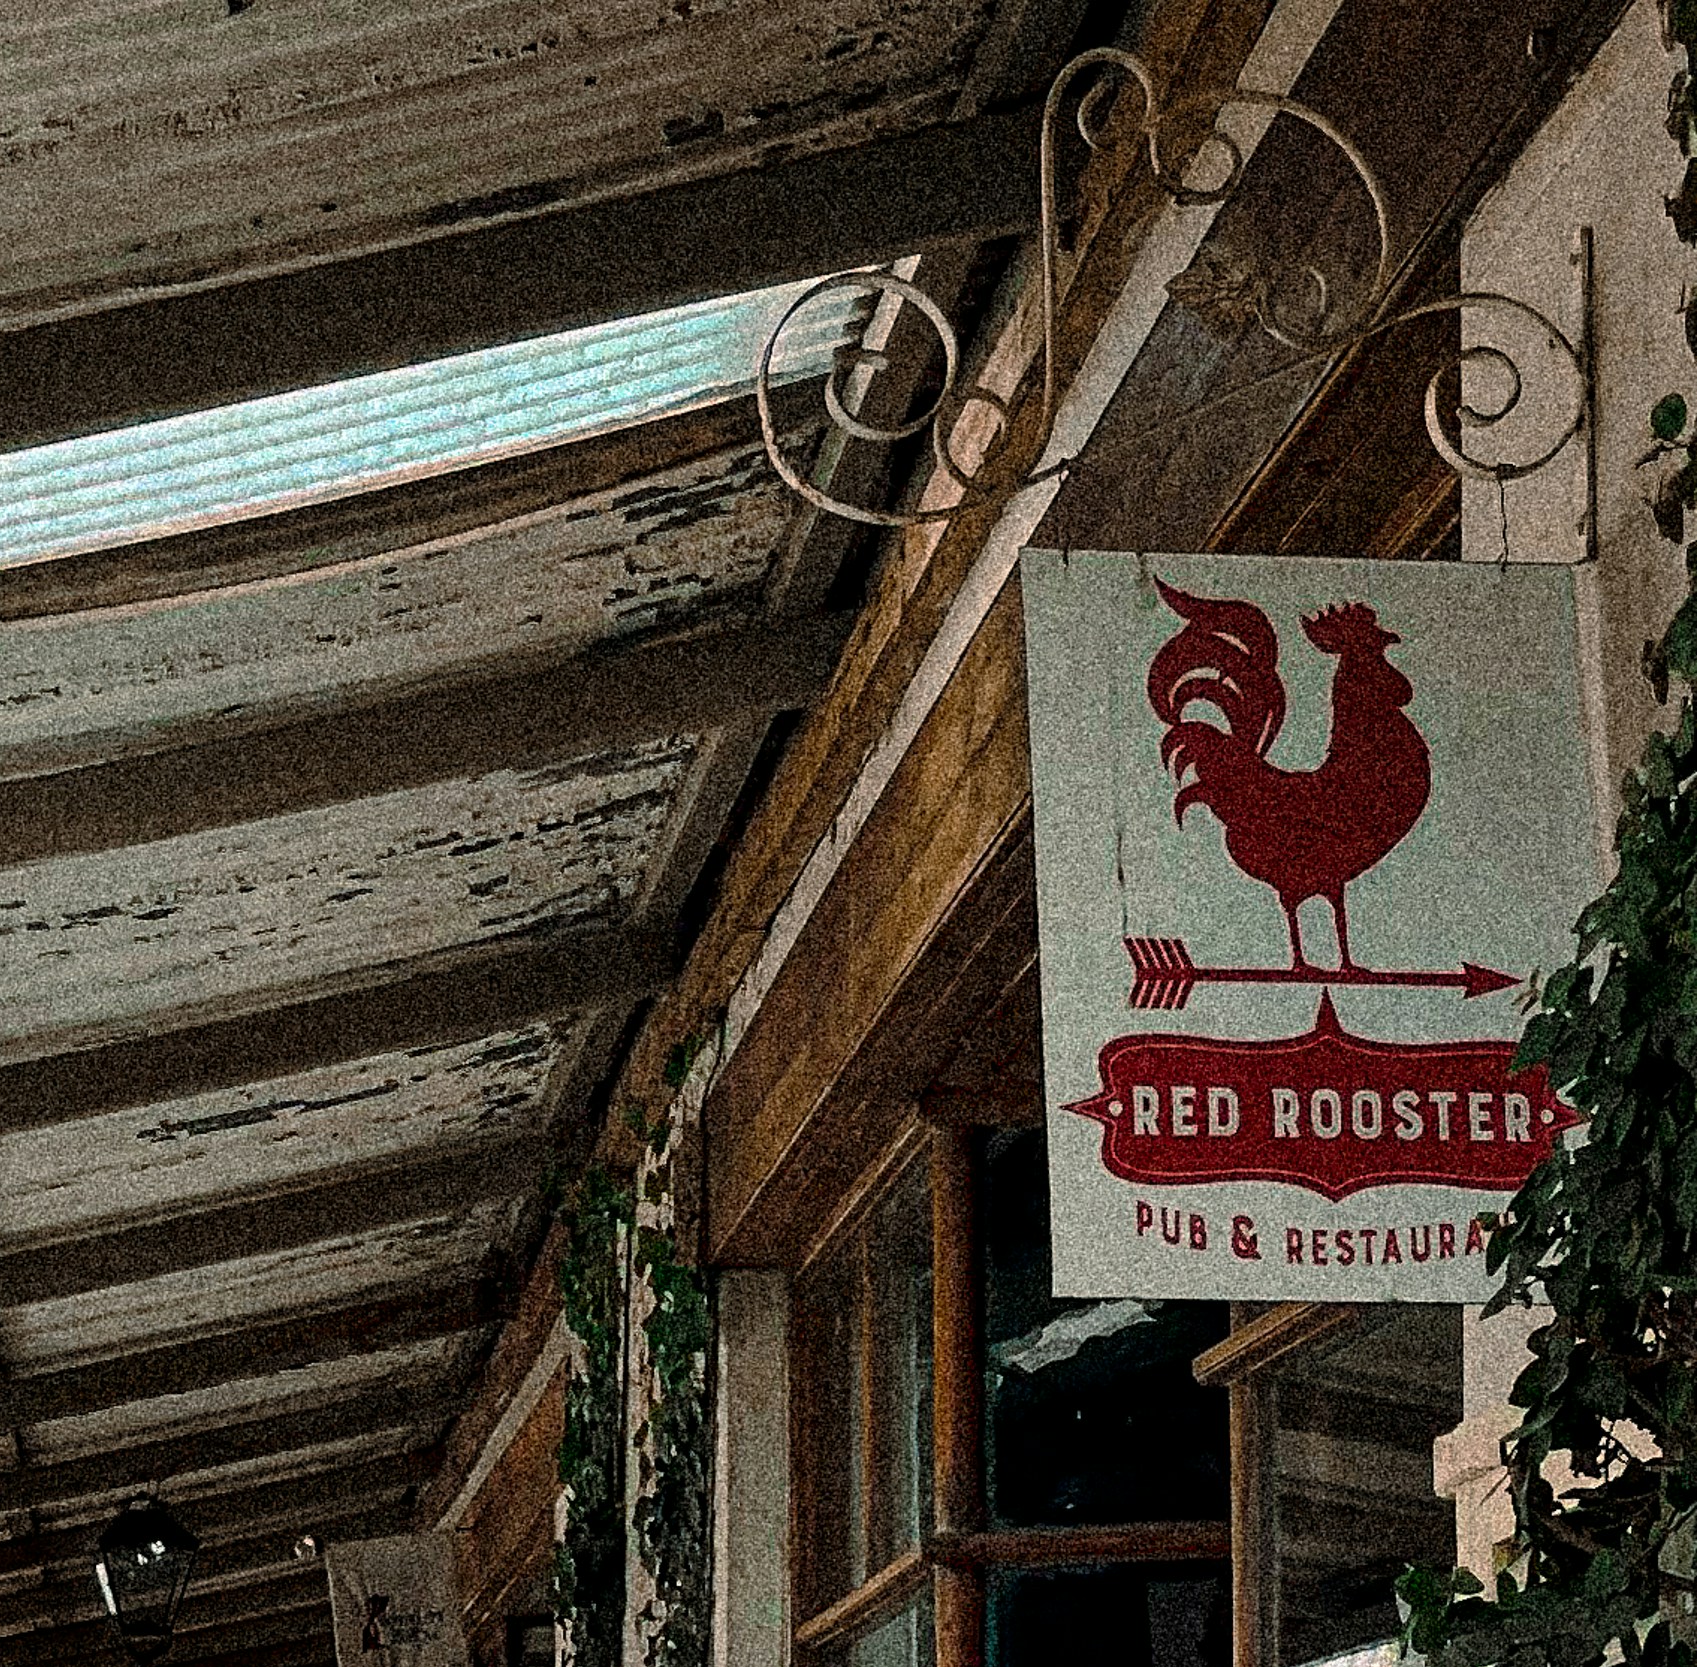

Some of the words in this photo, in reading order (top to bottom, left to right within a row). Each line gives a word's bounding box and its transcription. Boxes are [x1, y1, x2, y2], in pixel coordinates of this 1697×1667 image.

[1132, 1085, 1240, 1137] RED
[1272, 1087, 1533, 1142] ROOSTER
[1136, 1200, 1207, 1250] PUB
[1231, 1214, 1262, 1260] &
[1285, 1219, 1486, 1266] RESTAURA
